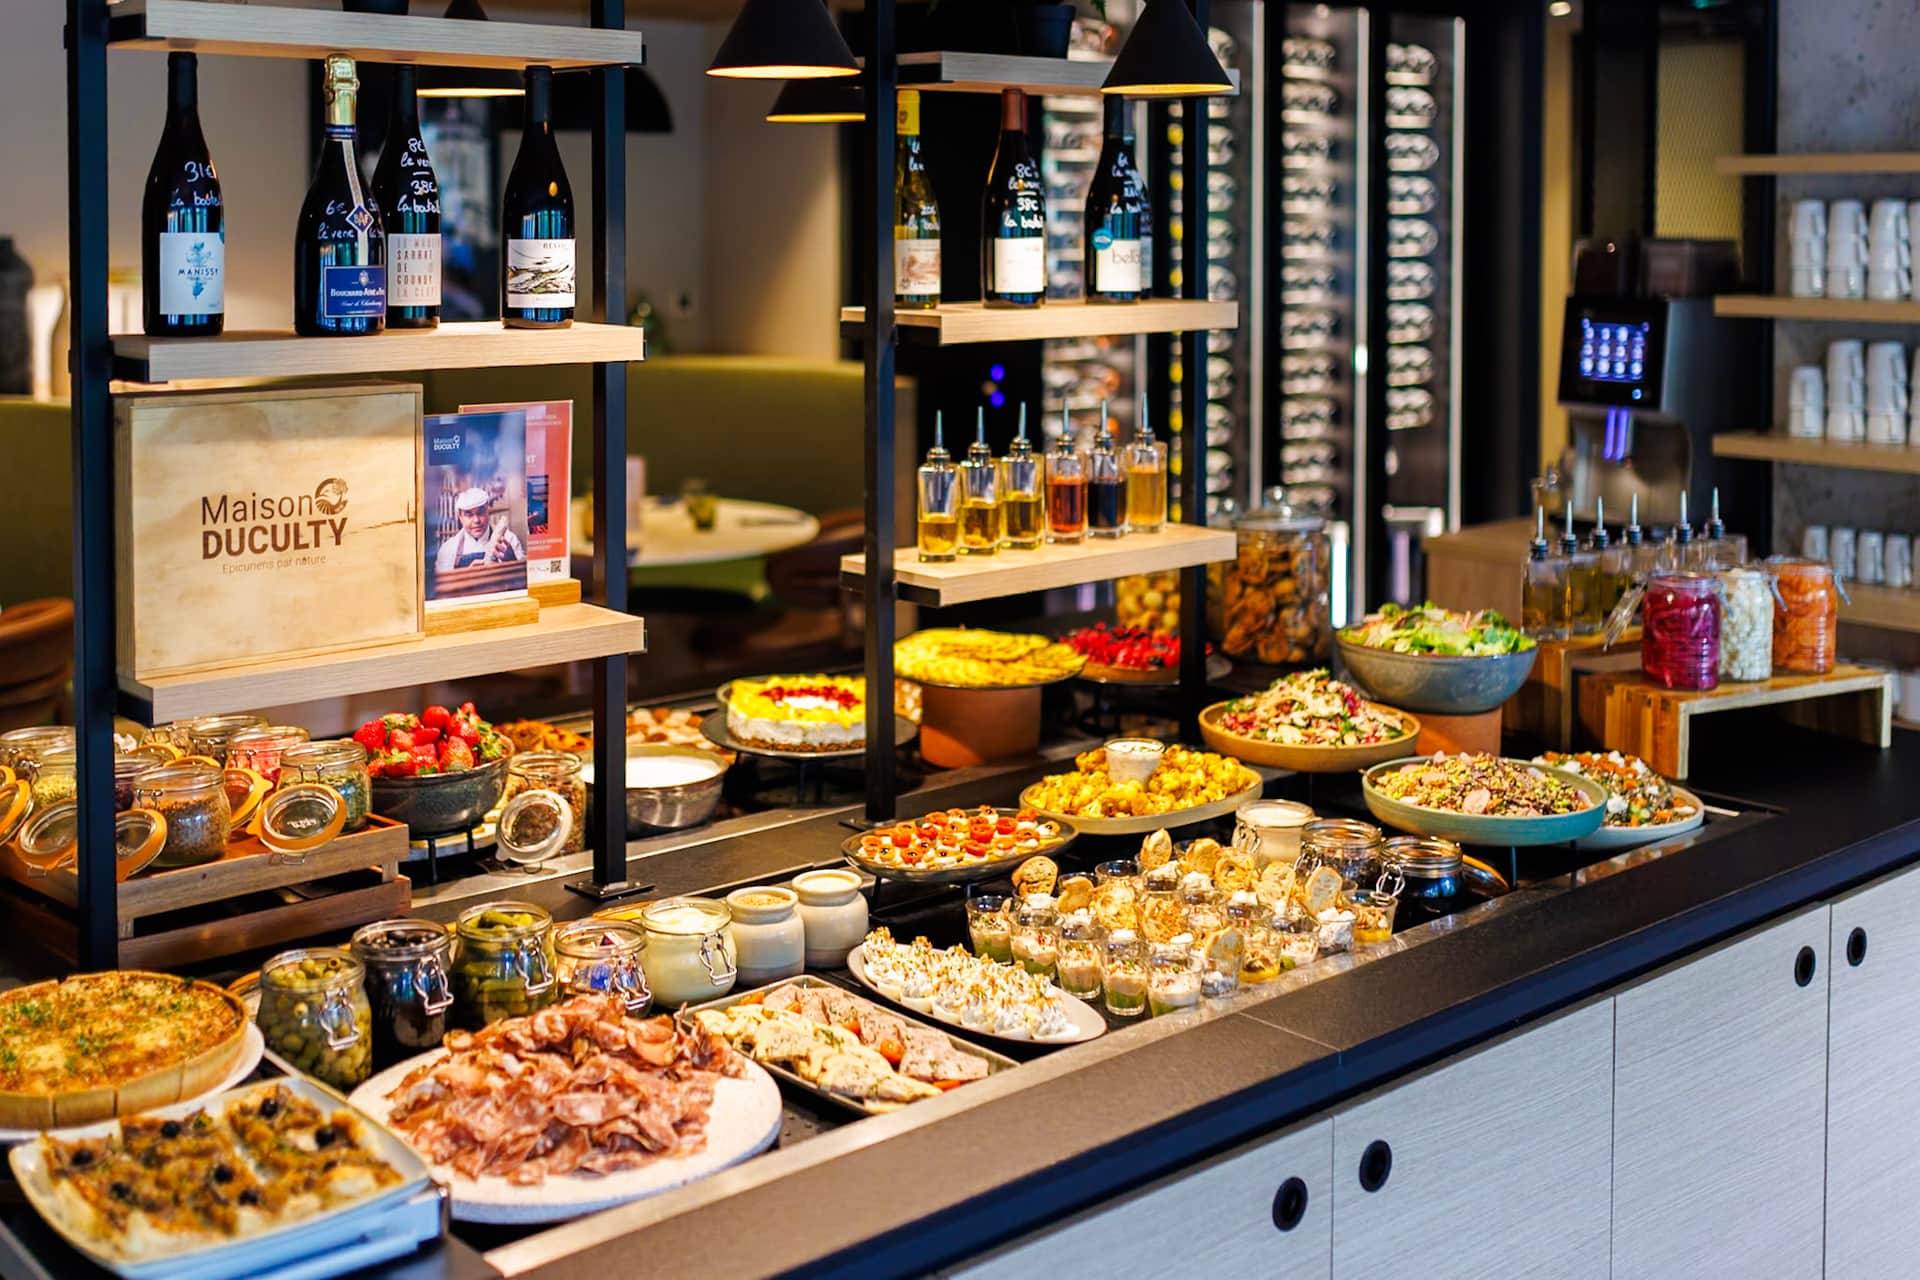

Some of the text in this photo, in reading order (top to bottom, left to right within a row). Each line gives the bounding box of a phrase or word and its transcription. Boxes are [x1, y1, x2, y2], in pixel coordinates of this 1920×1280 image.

[202, 491, 313, 526] Maison
[202, 517, 348, 560] DUCULTY
[277, 557, 293, 570] par
[295, 554, 327, 567] nature
